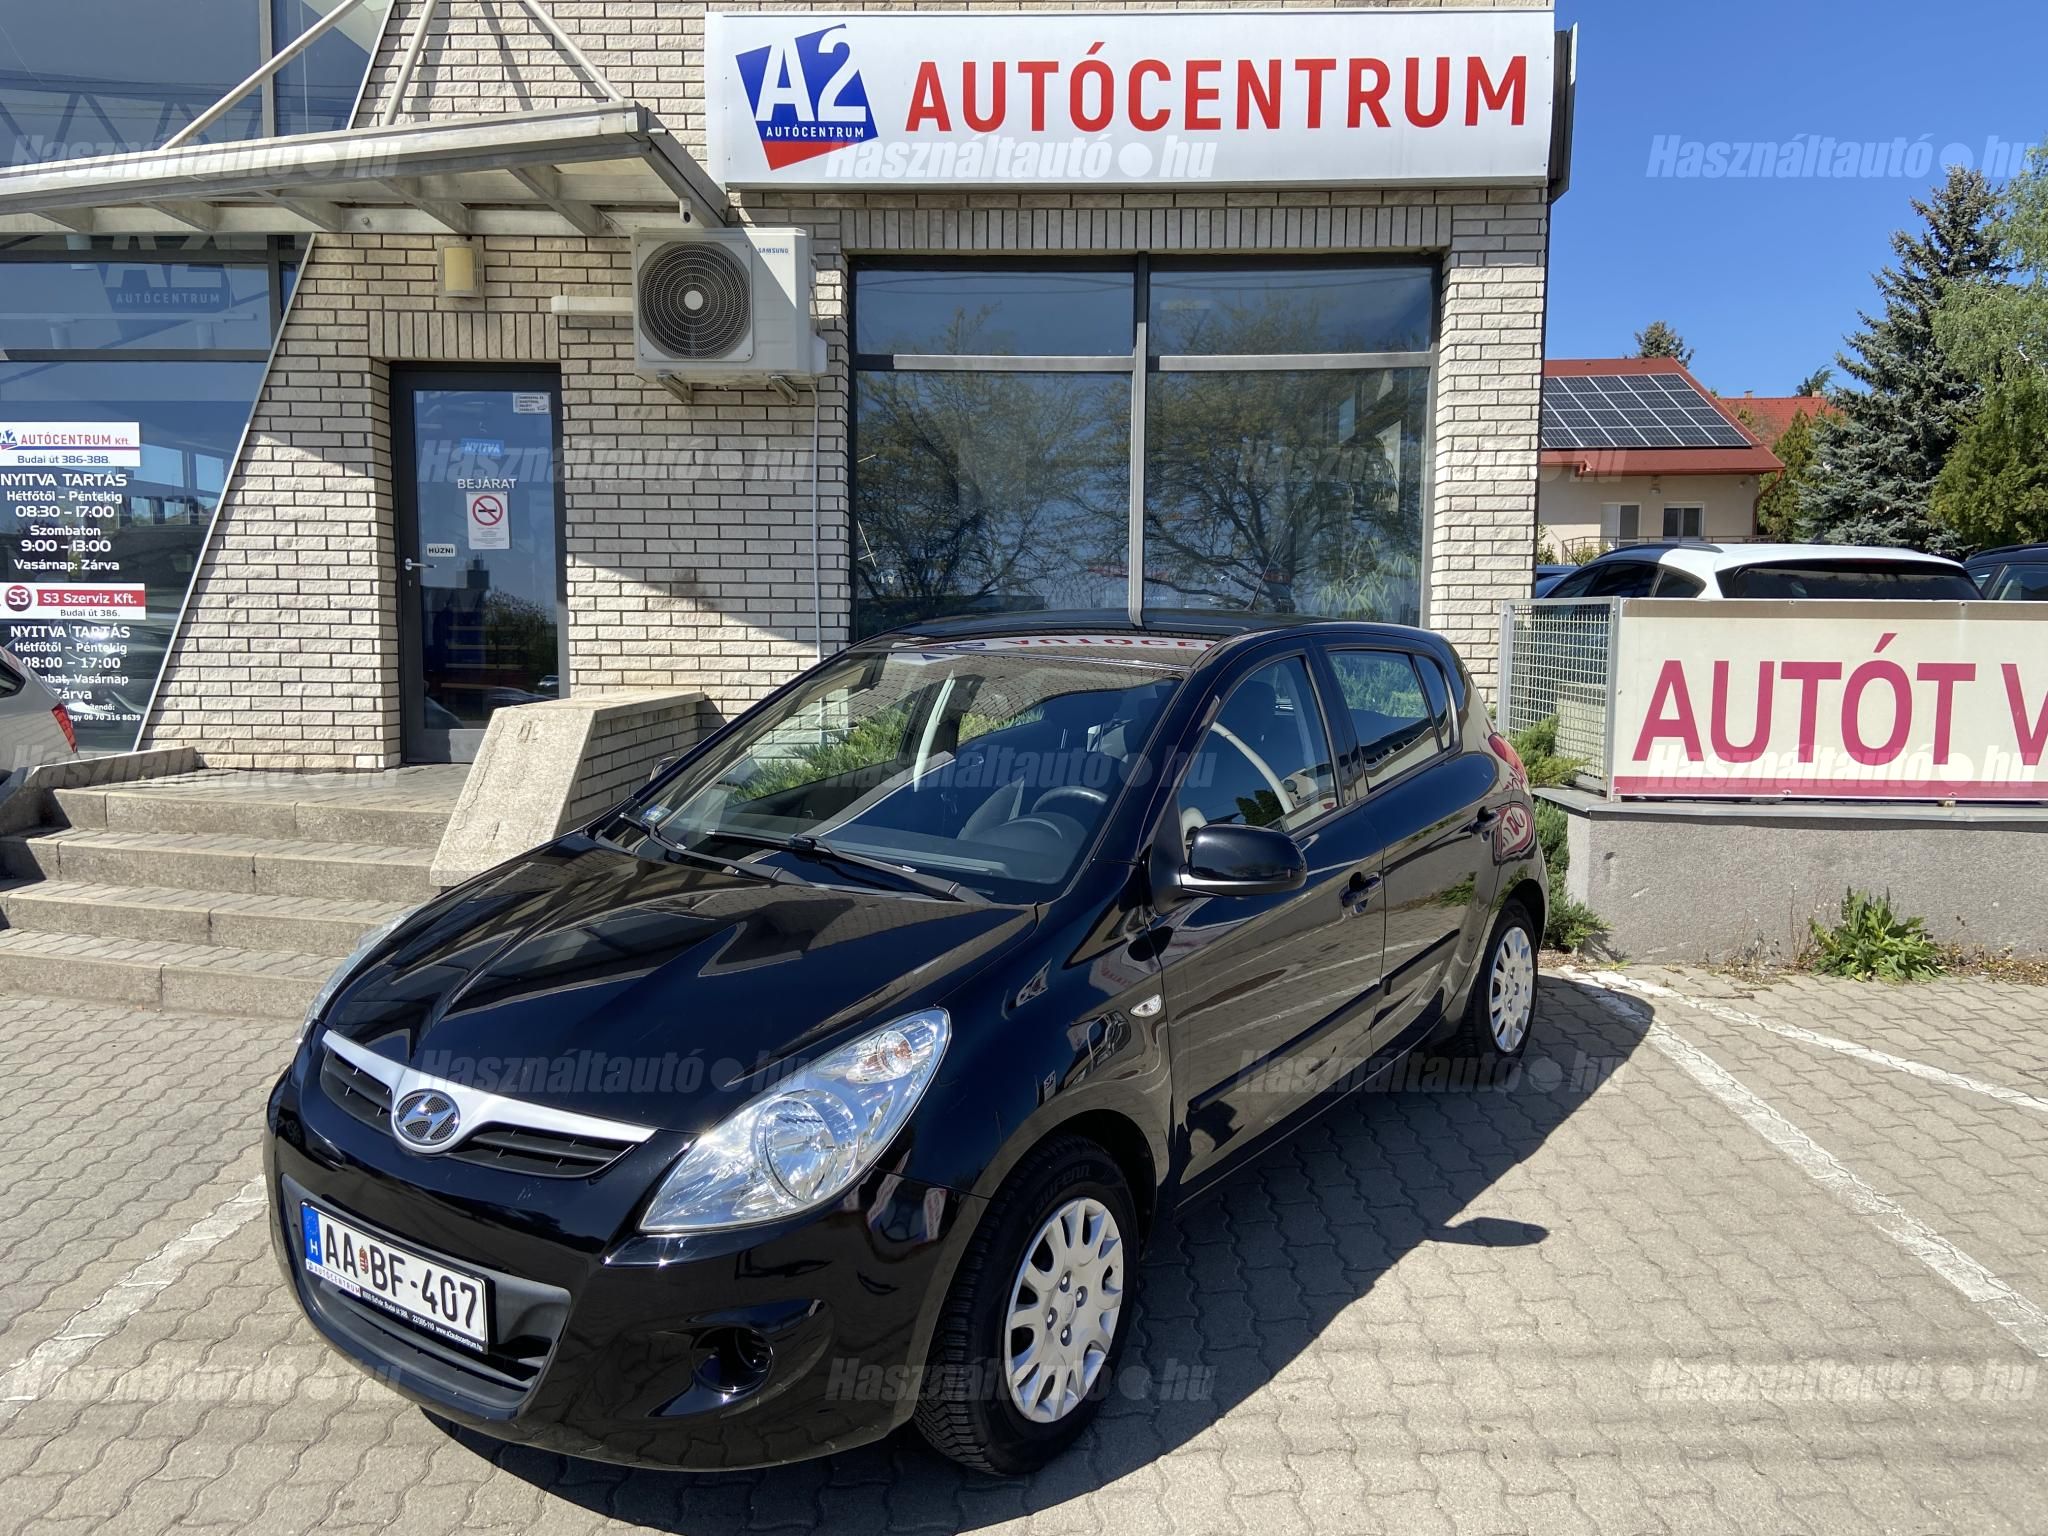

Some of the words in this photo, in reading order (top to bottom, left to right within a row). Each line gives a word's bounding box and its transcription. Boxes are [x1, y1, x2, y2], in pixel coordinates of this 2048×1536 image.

[754, 26, 867, 122] A2
[904, 41, 1528, 133] AUTÓCENTRUM
[766, 124, 864, 138] AUTÓCENTRUM
[20, 432, 111, 445] AUTÓCENTRUM
[17, 455, 46, 464] Budai
[49, 455, 59, 464] út
[0, 473, 57, 487] NYITVA
[62, 470, 128, 487] TARTÁS
[457, 476, 517, 489] BEJÁRAT
[6, 490, 56, 502] Hétfőtől
[68, 490, 123, 504] Péntekig
[15, 505, 61, 518] 08:30
[75, 505, 115, 518] 17:00
[30, 525, 101, 536] Szombaton
[20, 539, 58, 552] 9:00
[72, 539, 112, 552] 13:00
[13, 559, 78, 572] Vasárnap:
[80, 559, 120, 571] Zárva
[8, 589, 29, 606] S3
[43, 592, 60, 604] S3
[63, 592, 110, 604] Szerviz
[113, 592, 137, 604] Kft.
[60, 609, 86, 617] Budai
[88, 609, 98, 617] út
[10, 625, 67, 638] NYITVA
[72, 622, 131, 639] TARTÁS
[15, 641, 62, 653] Hétfőtől
[76, 641, 128, 655] Péntekig
[22, 656, 63, 669] 08:00
[80, 656, 121, 669] 17:00
[73, 673, 129, 686] Vasárnap
[1631, 632, 1977, 766] AUTÓT
[310, 1238, 319, 1256] H
[325, 1223, 359, 1279] AA
